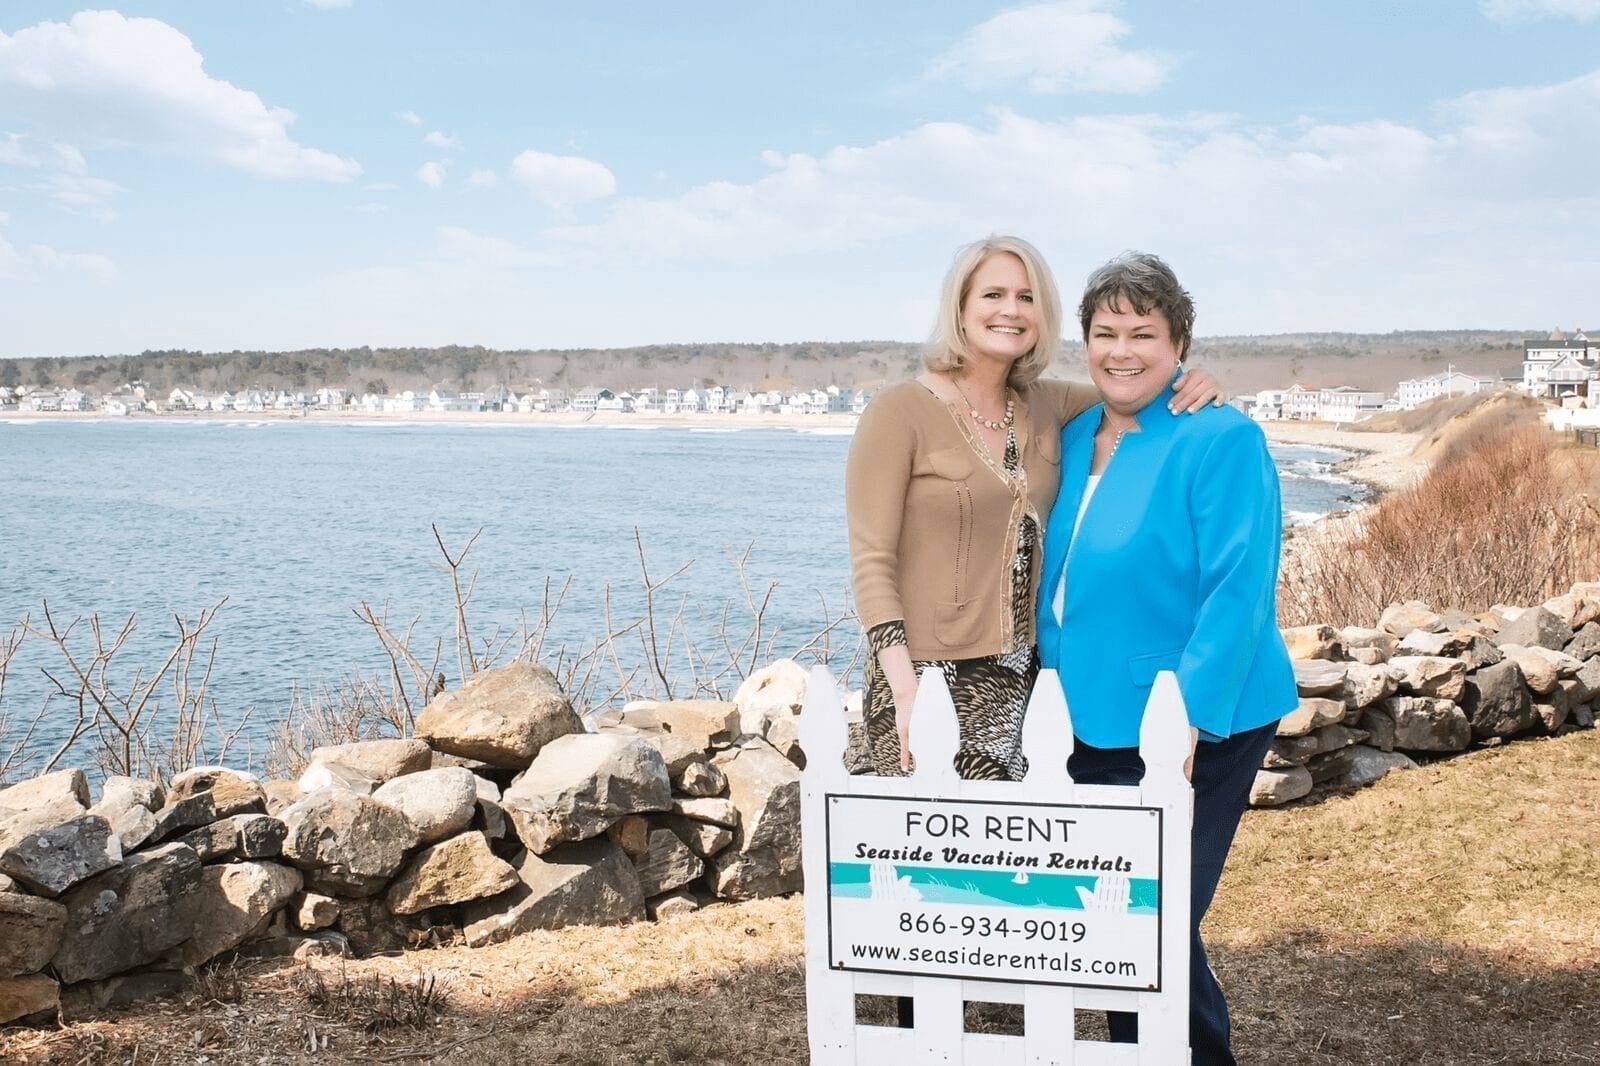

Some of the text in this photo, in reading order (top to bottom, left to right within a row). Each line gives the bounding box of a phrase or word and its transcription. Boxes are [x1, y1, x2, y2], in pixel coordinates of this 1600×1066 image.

[905, 811, 1077, 843] FOR RENT
[855, 842, 1132, 873] Seaside Vacation Rentals
[899, 912, 1087, 943] 866-934-9019
[851, 943, 1137, 976] www.seasiderentals.com
